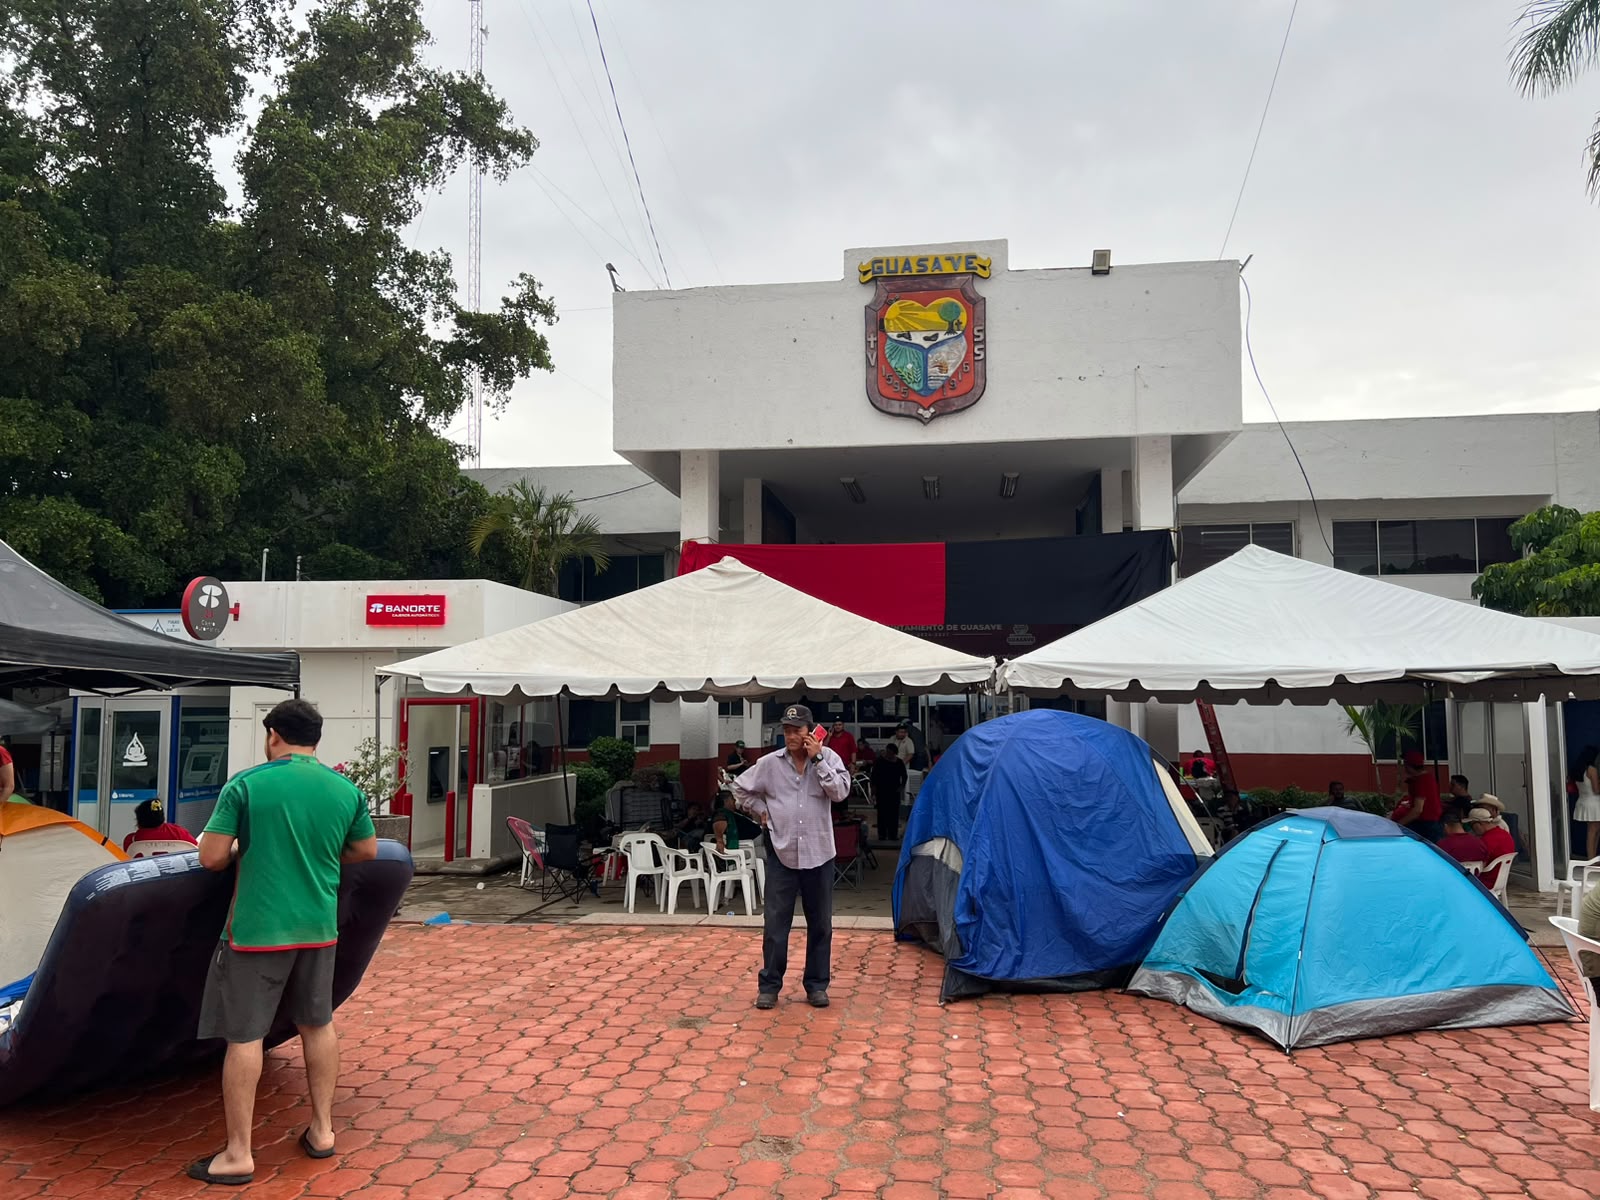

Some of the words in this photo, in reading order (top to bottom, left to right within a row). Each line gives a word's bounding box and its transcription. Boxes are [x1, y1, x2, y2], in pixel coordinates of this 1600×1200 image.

[871, 254, 978, 275] GUASAVE
[881, 364, 909, 398] 1595
[943, 361, 970, 396] 1916
[385, 604, 441, 613] BANORTE
